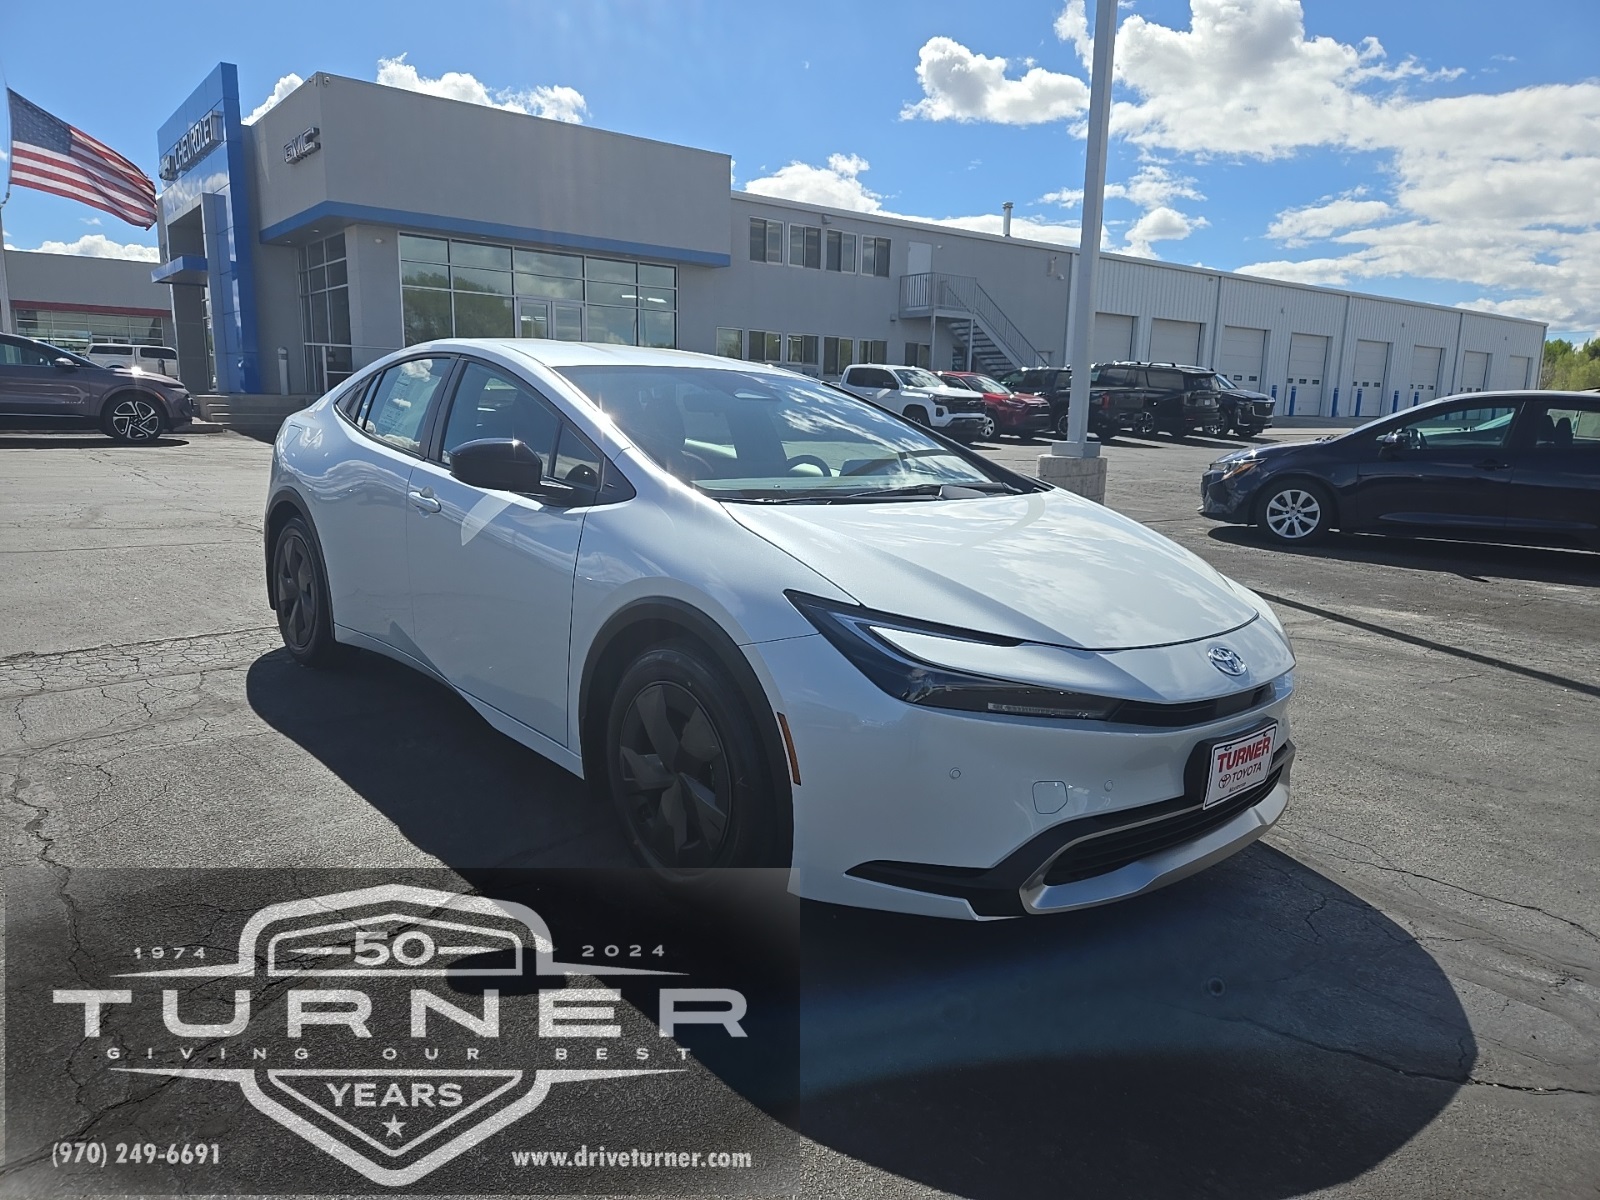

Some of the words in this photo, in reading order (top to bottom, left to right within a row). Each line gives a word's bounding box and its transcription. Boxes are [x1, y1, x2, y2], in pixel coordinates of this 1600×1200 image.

[174, 115, 214, 170] CHEVROLET
[284, 127, 320, 163] GMC
[1218, 736, 1271, 773] TURNER
[1232, 762, 1261, 782] TOYOTA
